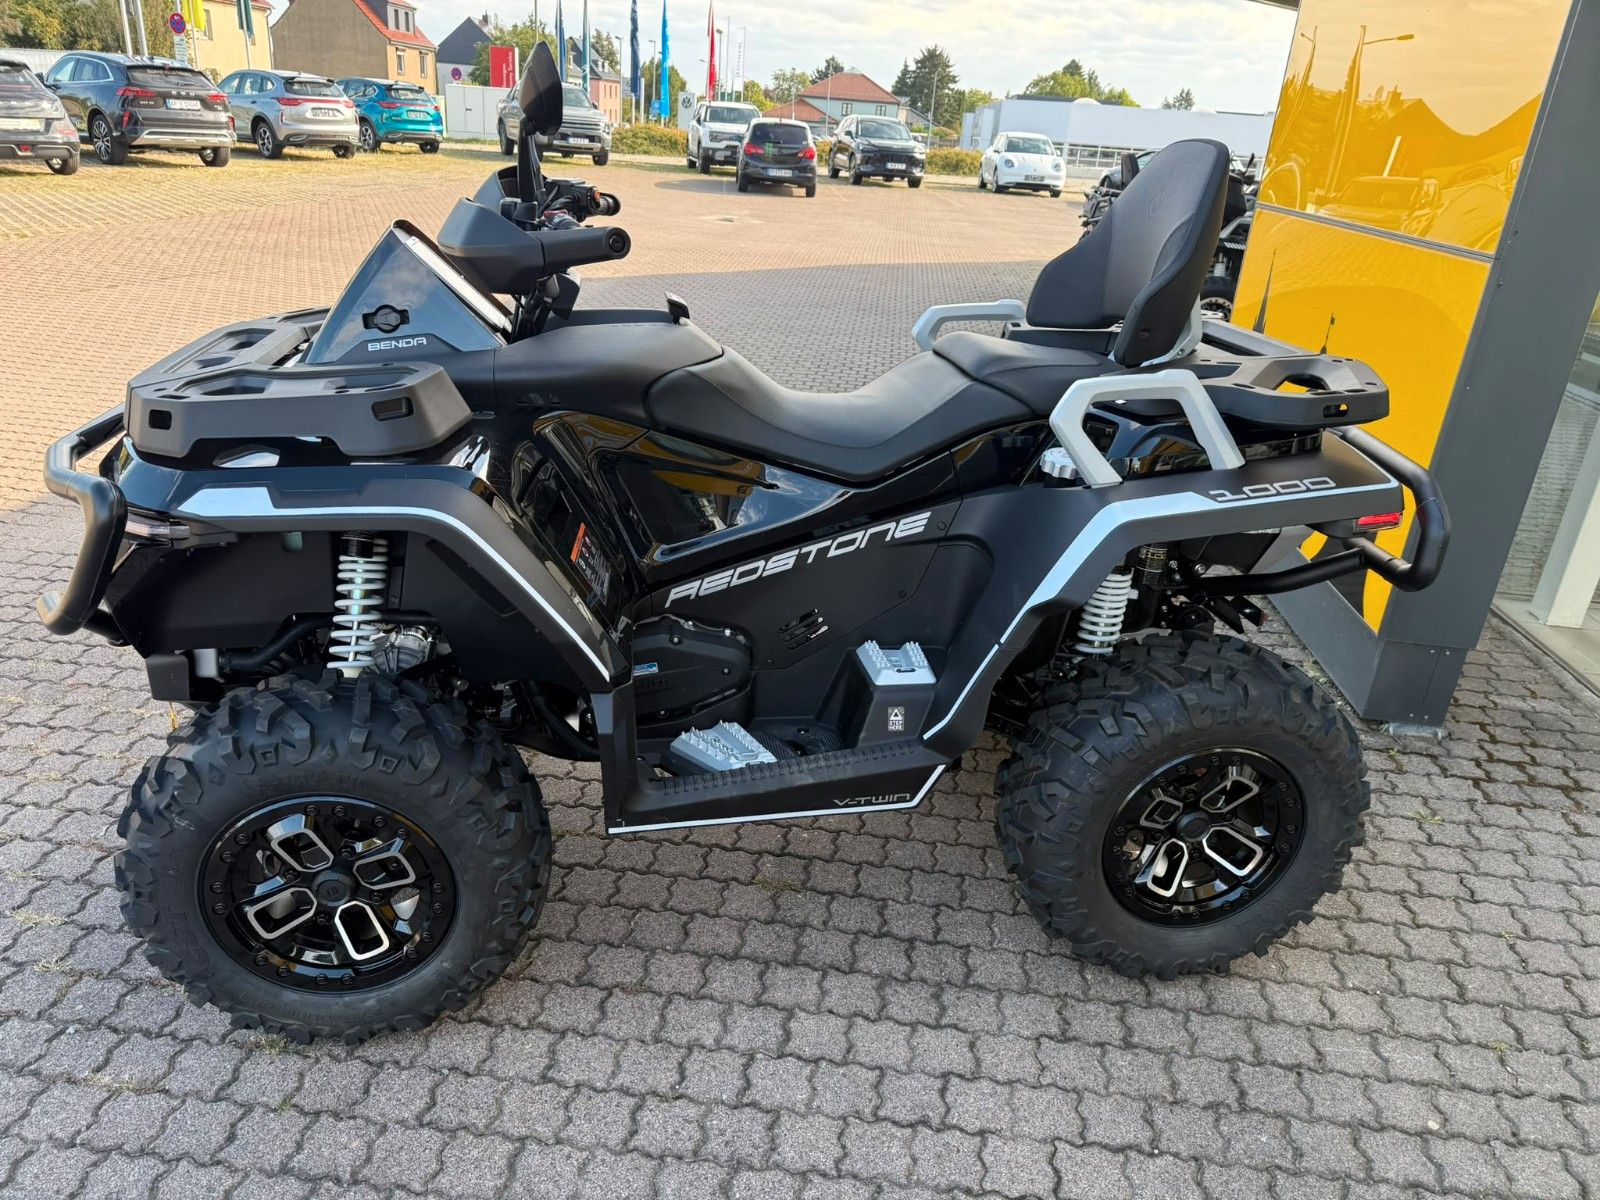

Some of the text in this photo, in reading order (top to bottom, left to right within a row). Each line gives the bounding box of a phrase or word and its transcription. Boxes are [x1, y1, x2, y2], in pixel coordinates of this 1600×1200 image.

[367, 336, 427, 351] BENDA
[1209, 476, 1336, 500] 1000
[665, 511, 931, 608] REDSTONE
[833, 793, 910, 806] V-TWIN
